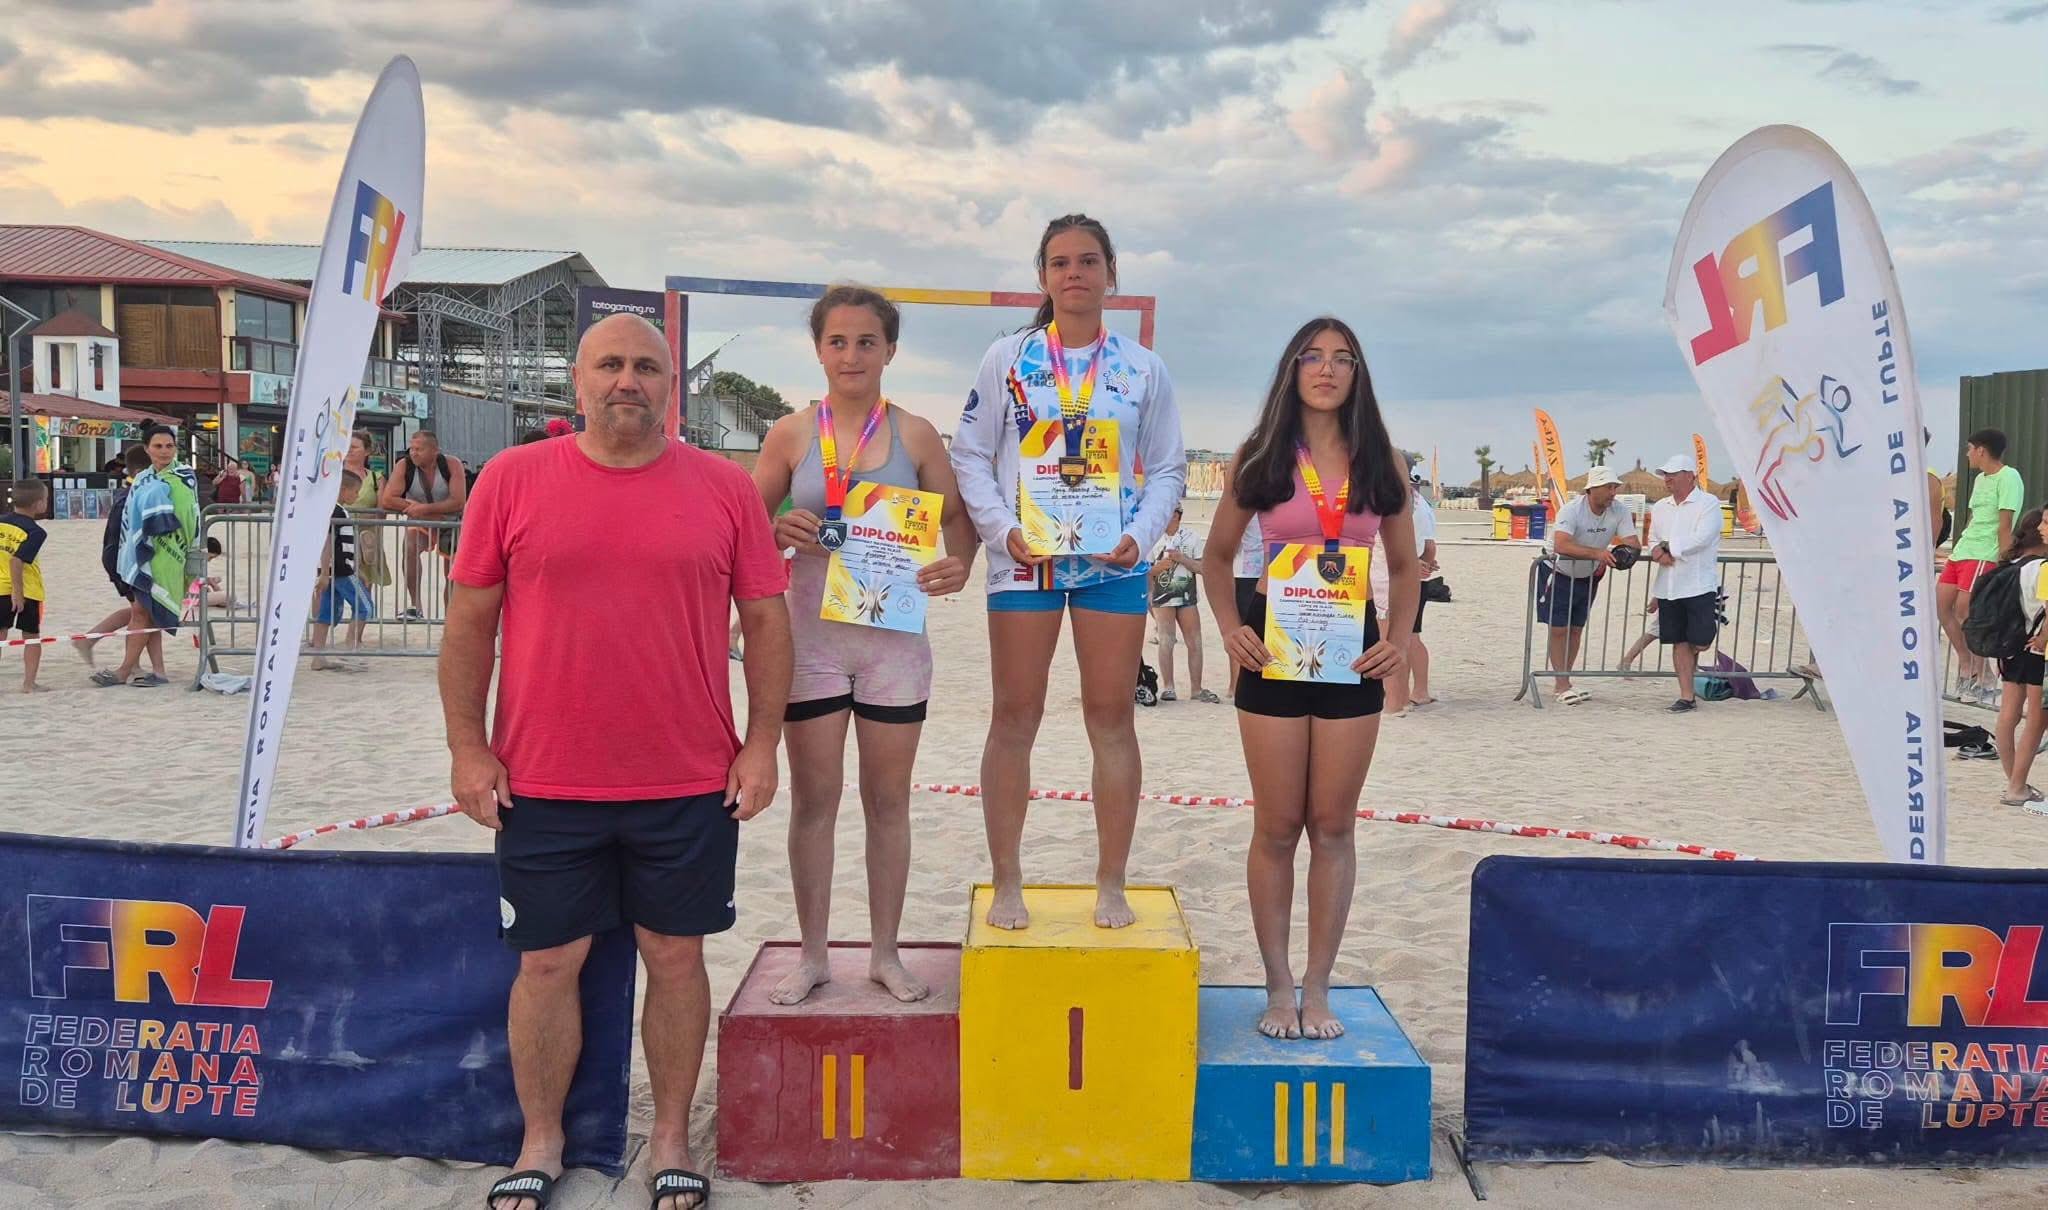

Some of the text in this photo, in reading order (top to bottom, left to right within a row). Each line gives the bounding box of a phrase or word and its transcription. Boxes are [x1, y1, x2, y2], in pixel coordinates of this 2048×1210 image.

[592, 300, 656, 314] totogaming.ro
[1036, 464, 1104, 475] DIPA
[852, 525, 920, 546] DIPLOMA
[1284, 587, 1350, 601] DIPLOMA
[247, 429, 305, 848] ATIA ROMANA DE LUPTE
[26, 894, 273, 1009] FRL
[1825, 922, 2048, 1028] FRL
[25, 1014, 261, 1054] FEDERATIA
[21, 1045, 259, 1087] ROMANA
[20, 1078, 259, 1117] DE LUPTE
[1827, 1100, 1883, 1128] DE
[493, 1177, 543, 1192] PUMA
[656, 1175, 703, 1190] PUMA
